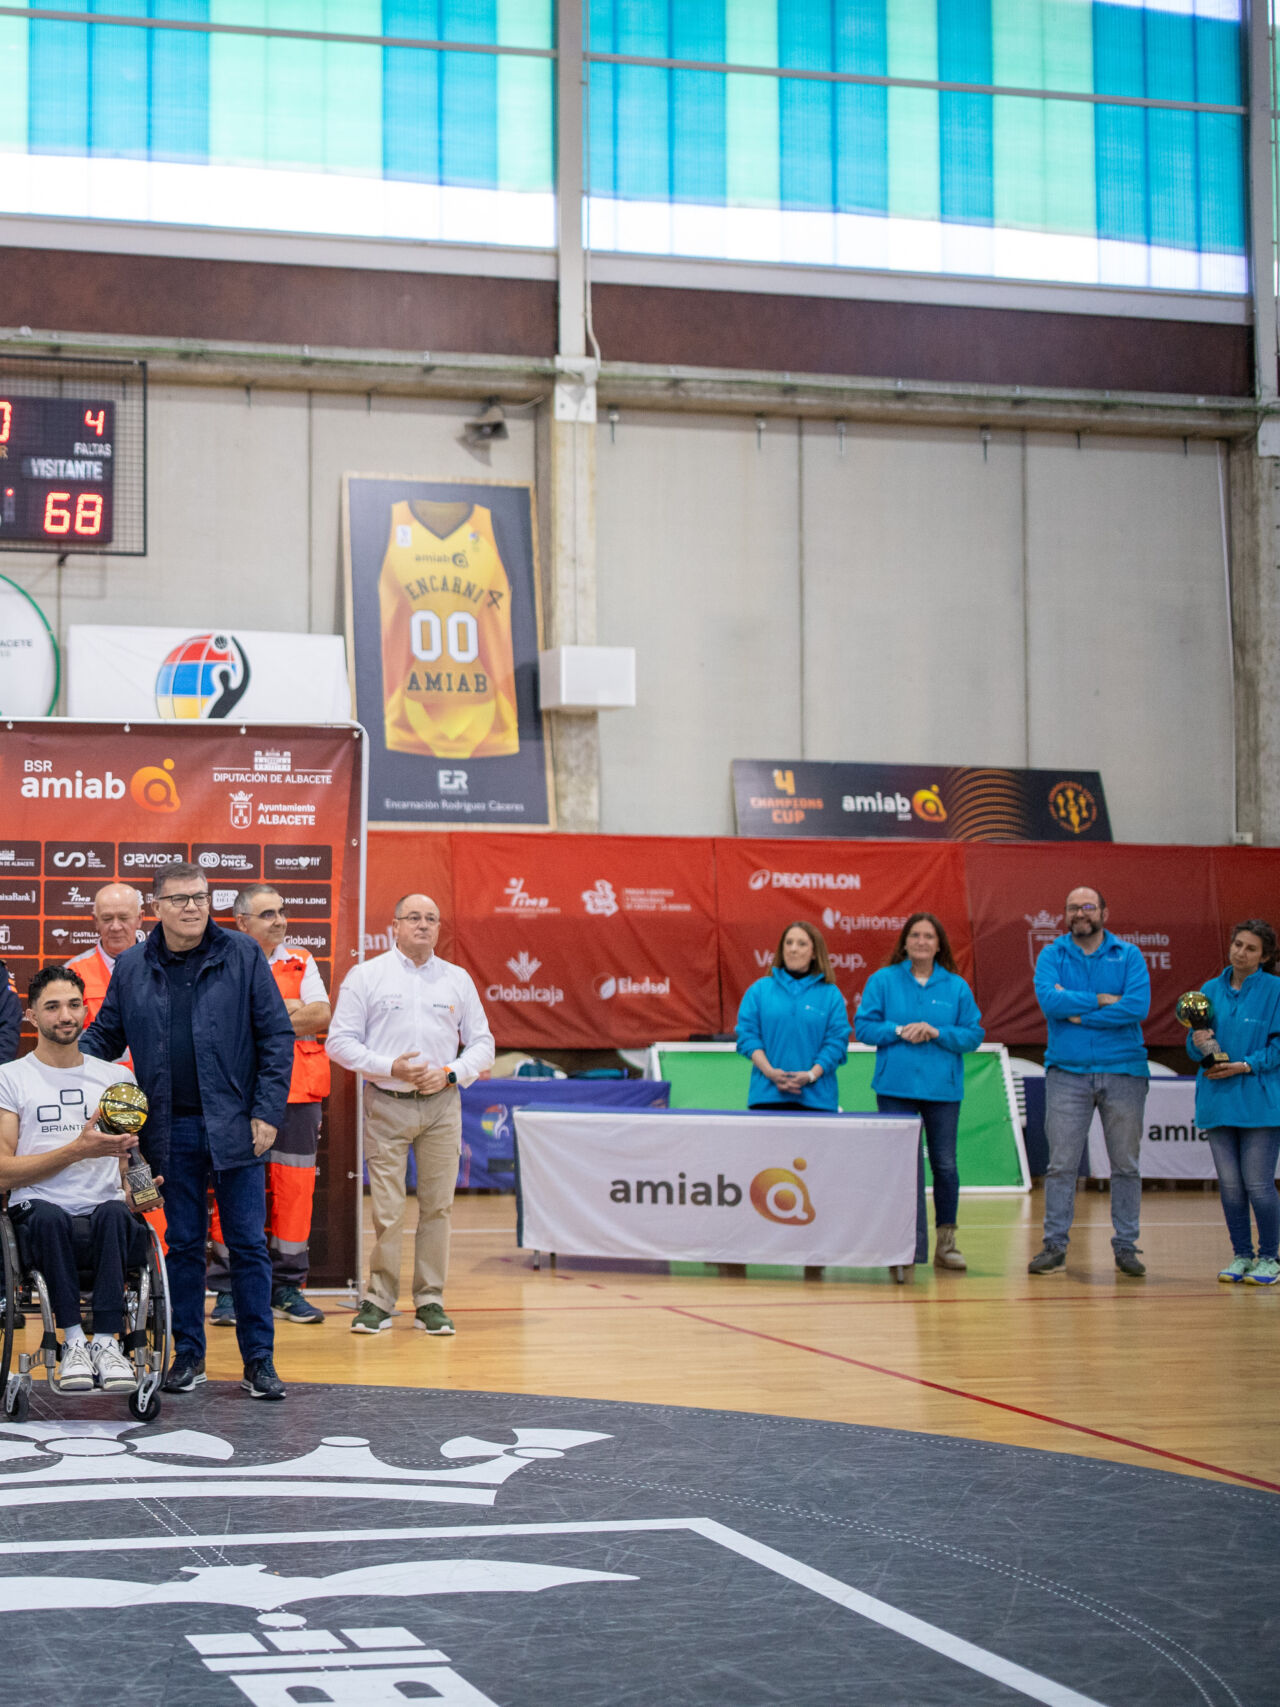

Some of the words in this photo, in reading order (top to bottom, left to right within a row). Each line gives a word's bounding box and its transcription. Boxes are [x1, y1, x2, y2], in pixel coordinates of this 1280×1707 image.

[84, 409, 106, 437] 4
[73, 442, 113, 458] FALTAS
[29, 457, 104, 482] VISITANTE
[43, 491, 104, 535] 68
[404, 575, 485, 604] ENCARNI
[409, 609, 480, 664] 00
[406, 671, 489, 694] AMIAB
[24, 760, 53, 773] BSR
[20, 770, 126, 800] amiab
[213, 773, 268, 783] DIPUTACIÓN
[270, 774, 283, 783] DE
[285, 775, 333, 785] ALBACETE
[257, 802, 316, 813] Ayuntamiento
[841, 791, 912, 813] amiab
[257, 814, 316, 826] ALBACETE
[771, 809, 806, 825] CUP
[123, 853, 183, 867] gaviota
[220, 859, 246, 867] ONCE
[771, 872, 861, 890] DECATHLON
[285, 897, 304, 905] KING
[283, 935, 326, 948] Globalcaja
[619, 976, 670, 995] Eledsol
[485, 984, 565, 1007] Globalcaja
[609, 1171, 743, 1208] amiab
